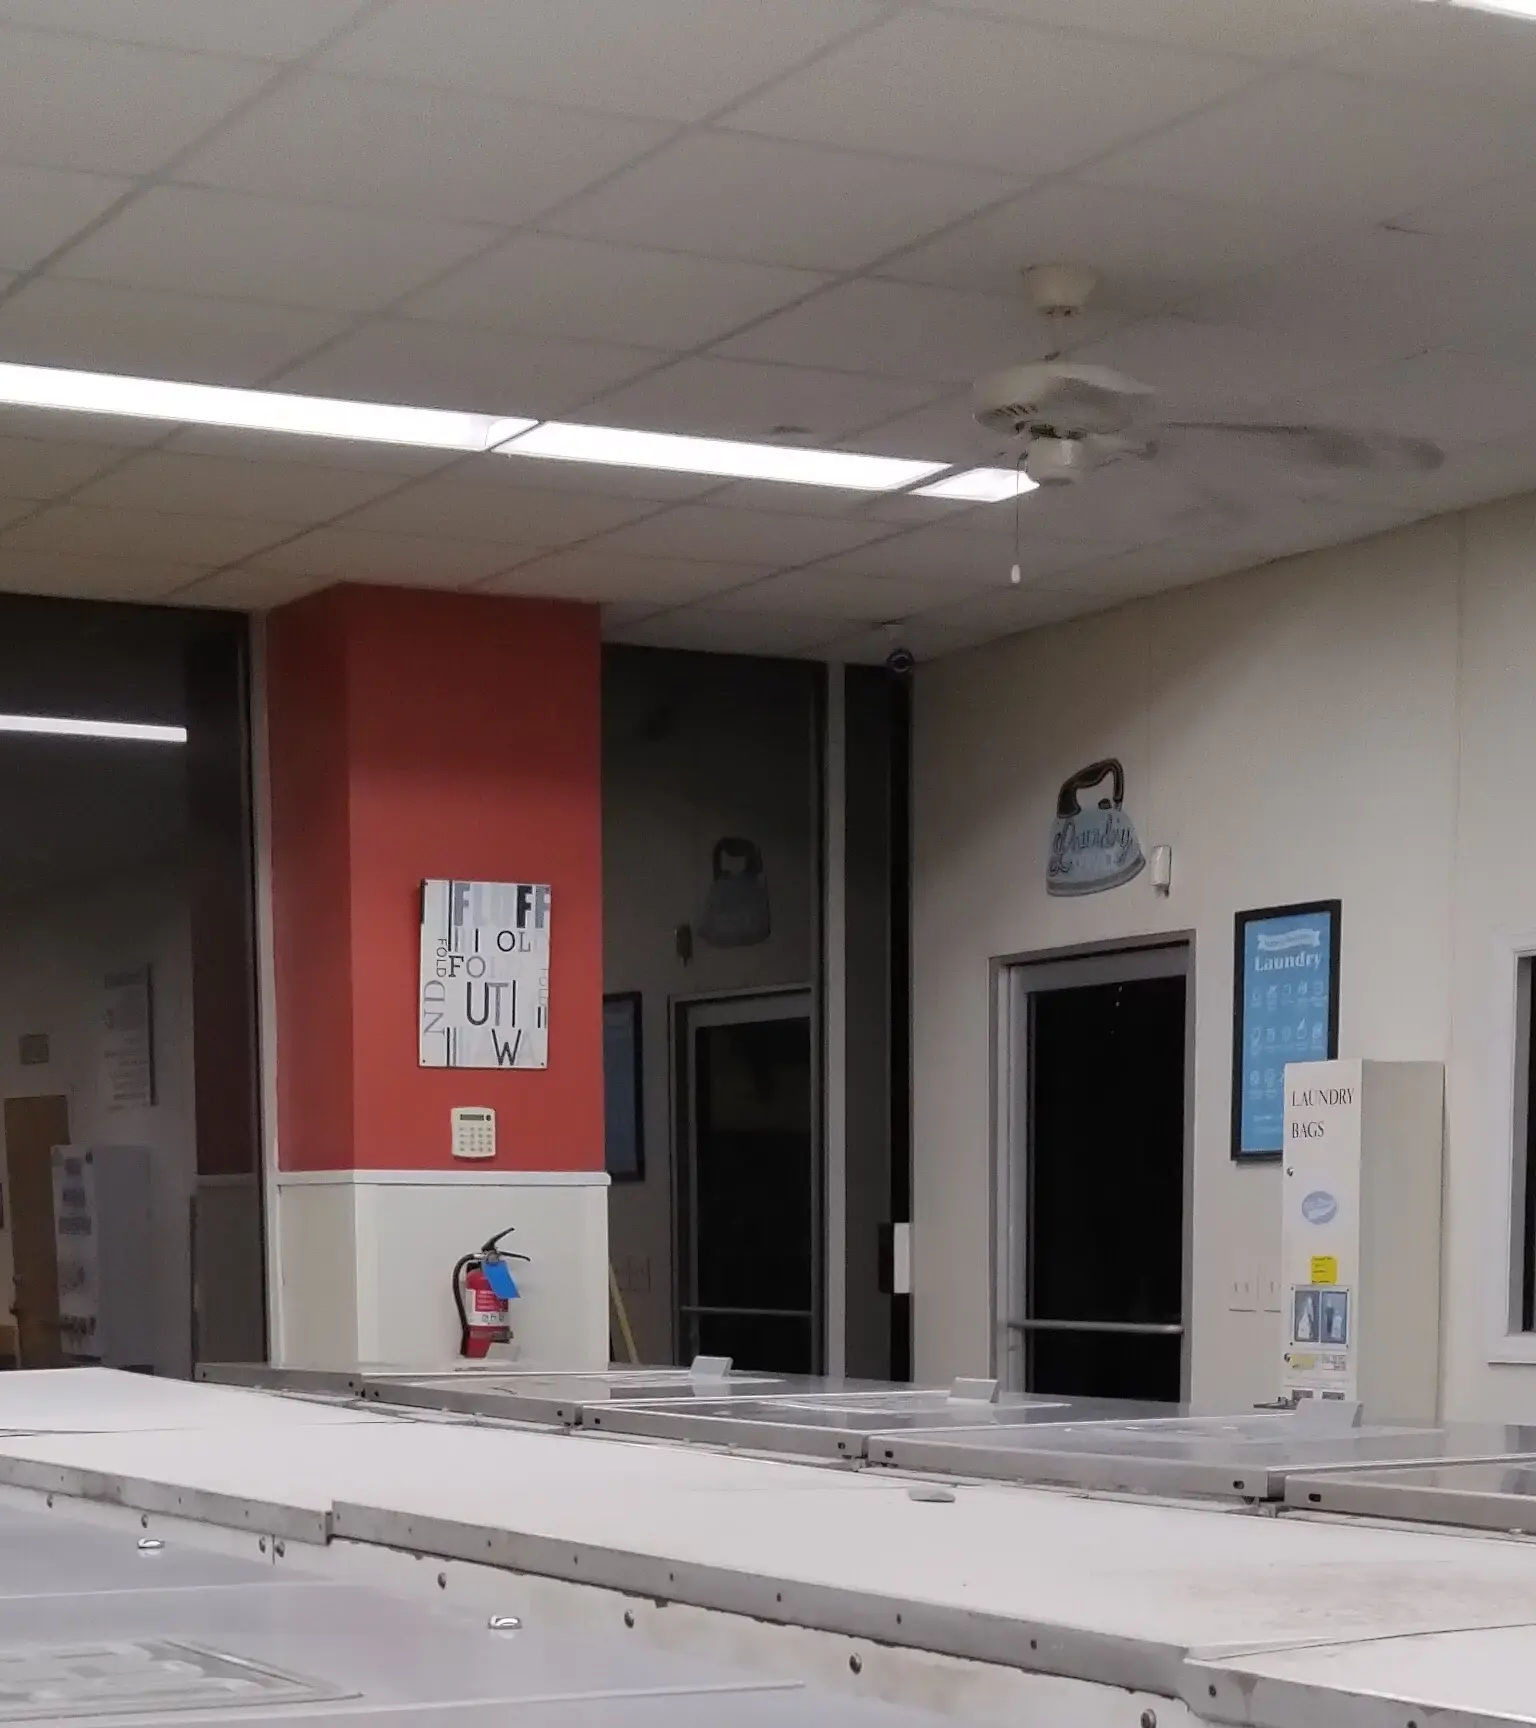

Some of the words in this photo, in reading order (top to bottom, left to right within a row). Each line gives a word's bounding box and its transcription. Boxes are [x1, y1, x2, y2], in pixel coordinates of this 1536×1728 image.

[1254, 951, 1322, 972] Laundry
[1292, 1087, 1355, 1107] LAUNDRY
[1292, 1122, 1325, 1139] BAGS
